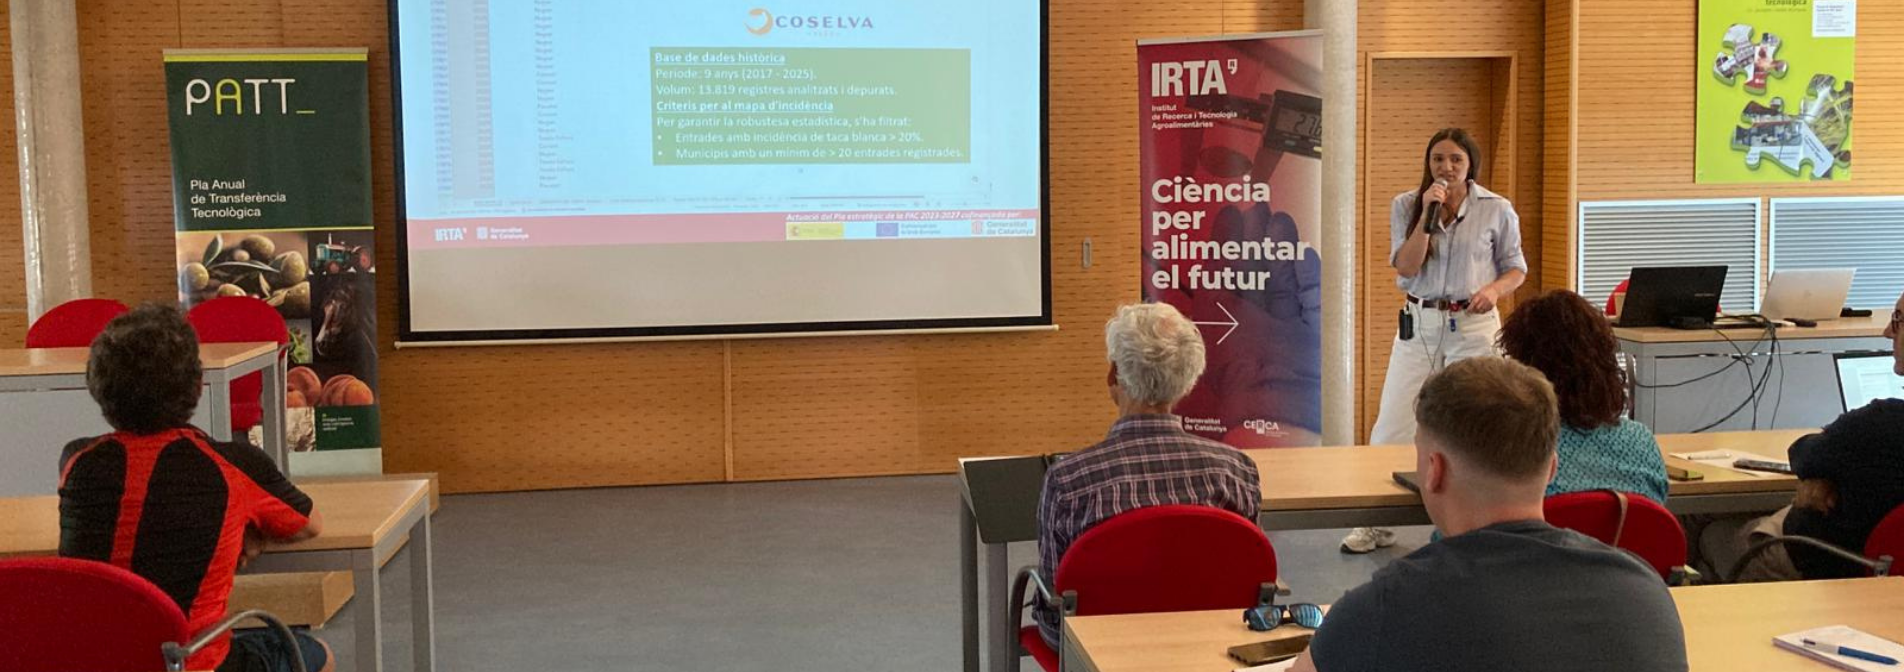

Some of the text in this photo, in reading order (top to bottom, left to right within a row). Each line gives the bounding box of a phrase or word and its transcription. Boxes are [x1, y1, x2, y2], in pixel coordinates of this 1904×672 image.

[775, 15, 874, 29] COSELVA
[655, 52, 682, 63] Base
[685, 52, 699, 63] de
[701, 51, 735, 63] dades
[704, 69, 711, 79] 9
[714, 71, 739, 81] anys
[742, 69, 773, 81] (2017
[656, 84, 696, 95] Volum:
[699, 84, 735, 95] 13.819
[738, 84, 785, 97] registres
[787, 84, 839, 95] analitzats
[847, 84, 898, 97] depurats.
[656, 101, 697, 111] Criteris
[700, 103, 718, 113] per
[721, 101, 732, 111] al
[734, 102, 765, 113] mapa
[1152, 104, 1177, 112] Institut
[1199, 111, 1238, 121] Tecnologia
[657, 117, 674, 127] Per
[677, 117, 721, 129] garantir
[724, 117, 734, 127] la
[736, 117, 790, 127] robustesa
[1152, 121, 1214, 130] Agroalimentàries
[676, 132, 724, 143] Entrades
[726, 132, 751, 143] amb
[810, 132, 824, 142] de
[827, 132, 849, 142] taca
[852, 131, 887, 142] blanca
[676, 148, 729, 160] Municipis
[731, 148, 757, 159] amb
[759, 149, 773, 159] un
[812, 147, 828, 158] de
[838, 148, 852, 158] 20
[854, 147, 902, 158] entrades
[190, 179, 245, 190] Pla Anual
[1151, 174, 1271, 204] Ciència
[191, 191, 287, 205] de Transferència
[191, 207, 261, 219] Tecnològica
[1152, 209, 1206, 236] per
[1152, 232, 1311, 261] alimentar
[1151, 264, 1271, 291] el futur
[1184, 416, 1221, 425] Generalitat
[1194, 424, 1228, 434] Catalunya
